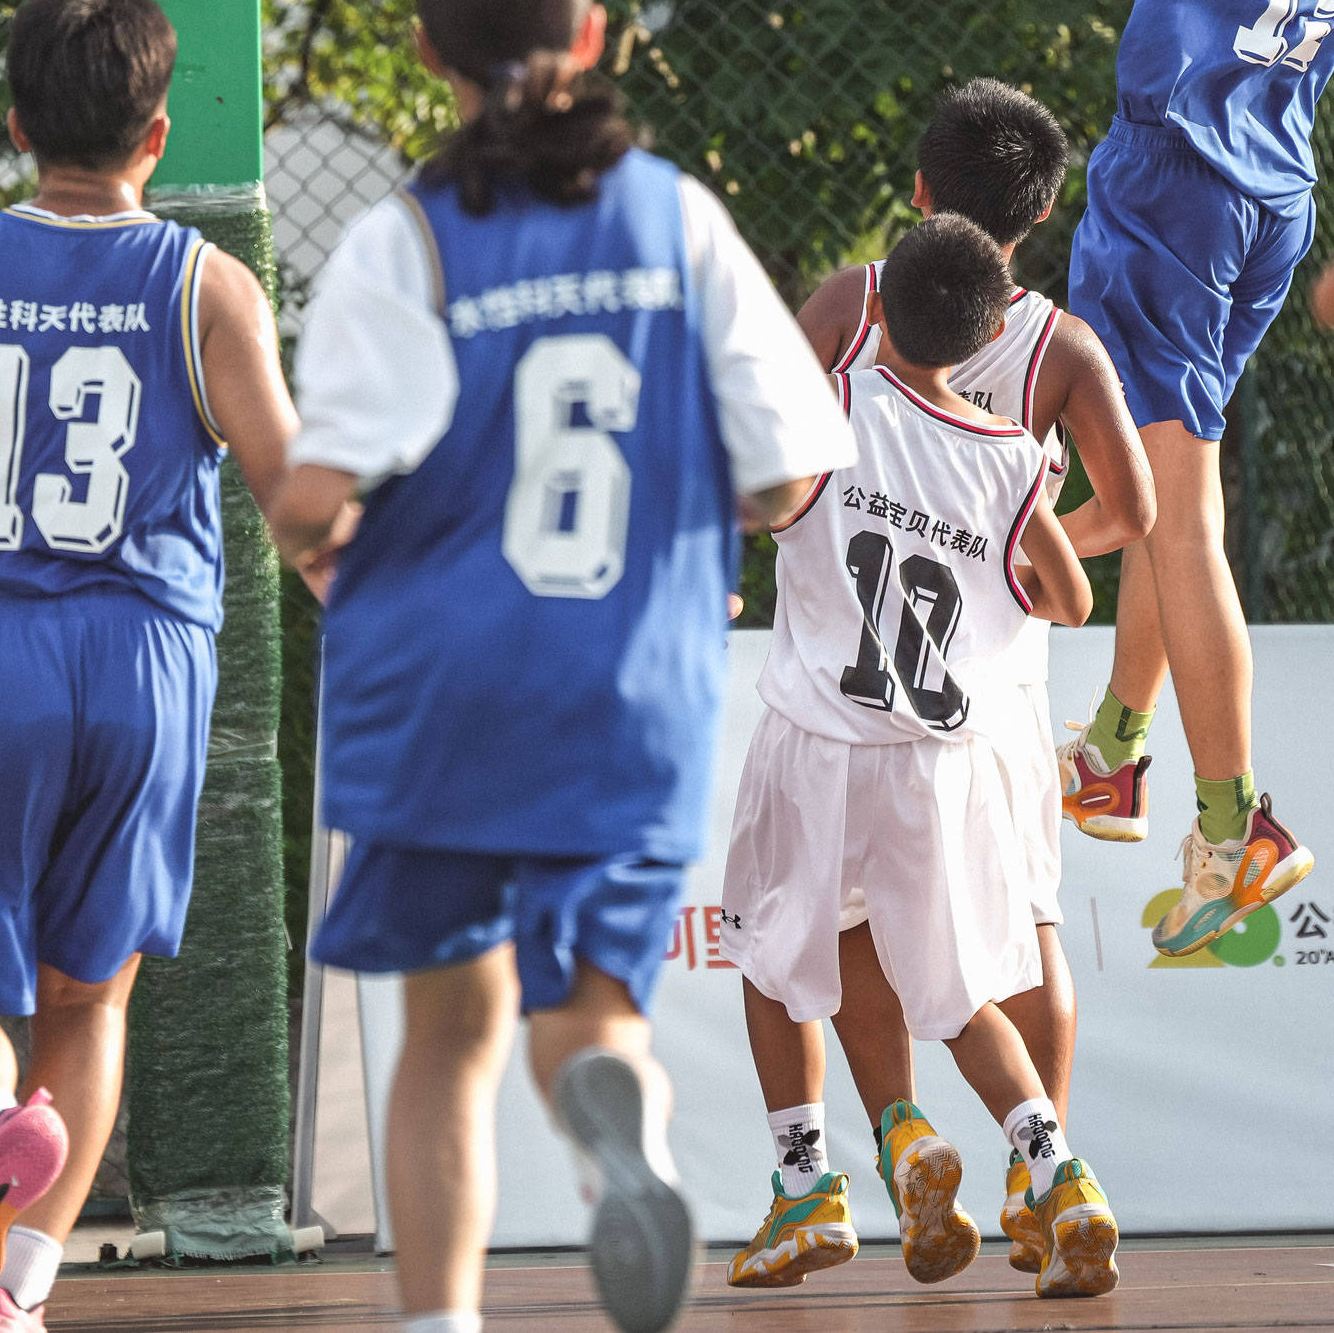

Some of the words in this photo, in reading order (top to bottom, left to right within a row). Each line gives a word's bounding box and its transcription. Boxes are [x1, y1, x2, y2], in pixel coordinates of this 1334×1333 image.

[501, 333, 642, 601] 6
[843, 485, 990, 562] 公益宝贝代表队
[840, 530, 970, 732] 10
